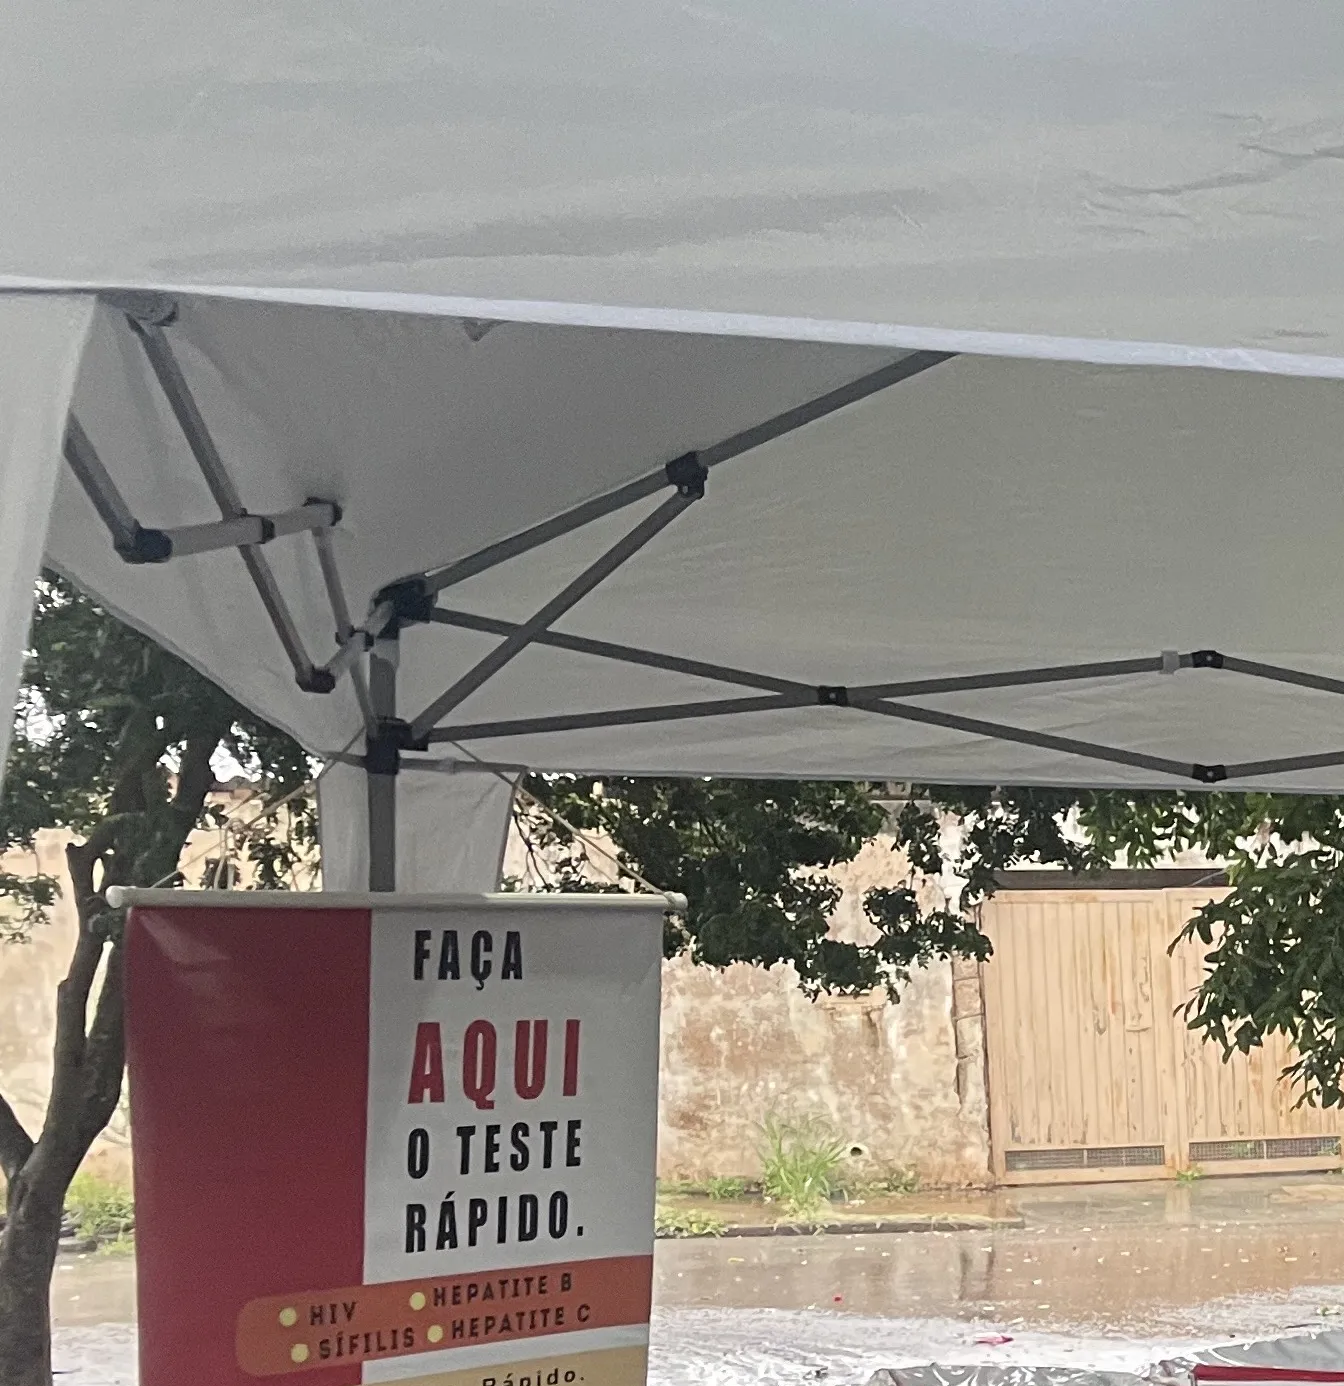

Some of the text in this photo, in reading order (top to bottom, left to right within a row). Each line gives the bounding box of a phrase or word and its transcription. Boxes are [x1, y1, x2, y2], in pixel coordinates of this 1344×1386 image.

[413, 930, 523, 991] FAÇA
[407, 1018, 582, 1110] AQUI
[407, 1120, 582, 1179] O TESTE
[405, 1191, 584, 1254] RÁPIDO.
[310, 1273, 572, 1326] HIV HEPATITE B
[319, 1304, 591, 1360] SÍFILIS HEPATITE C
